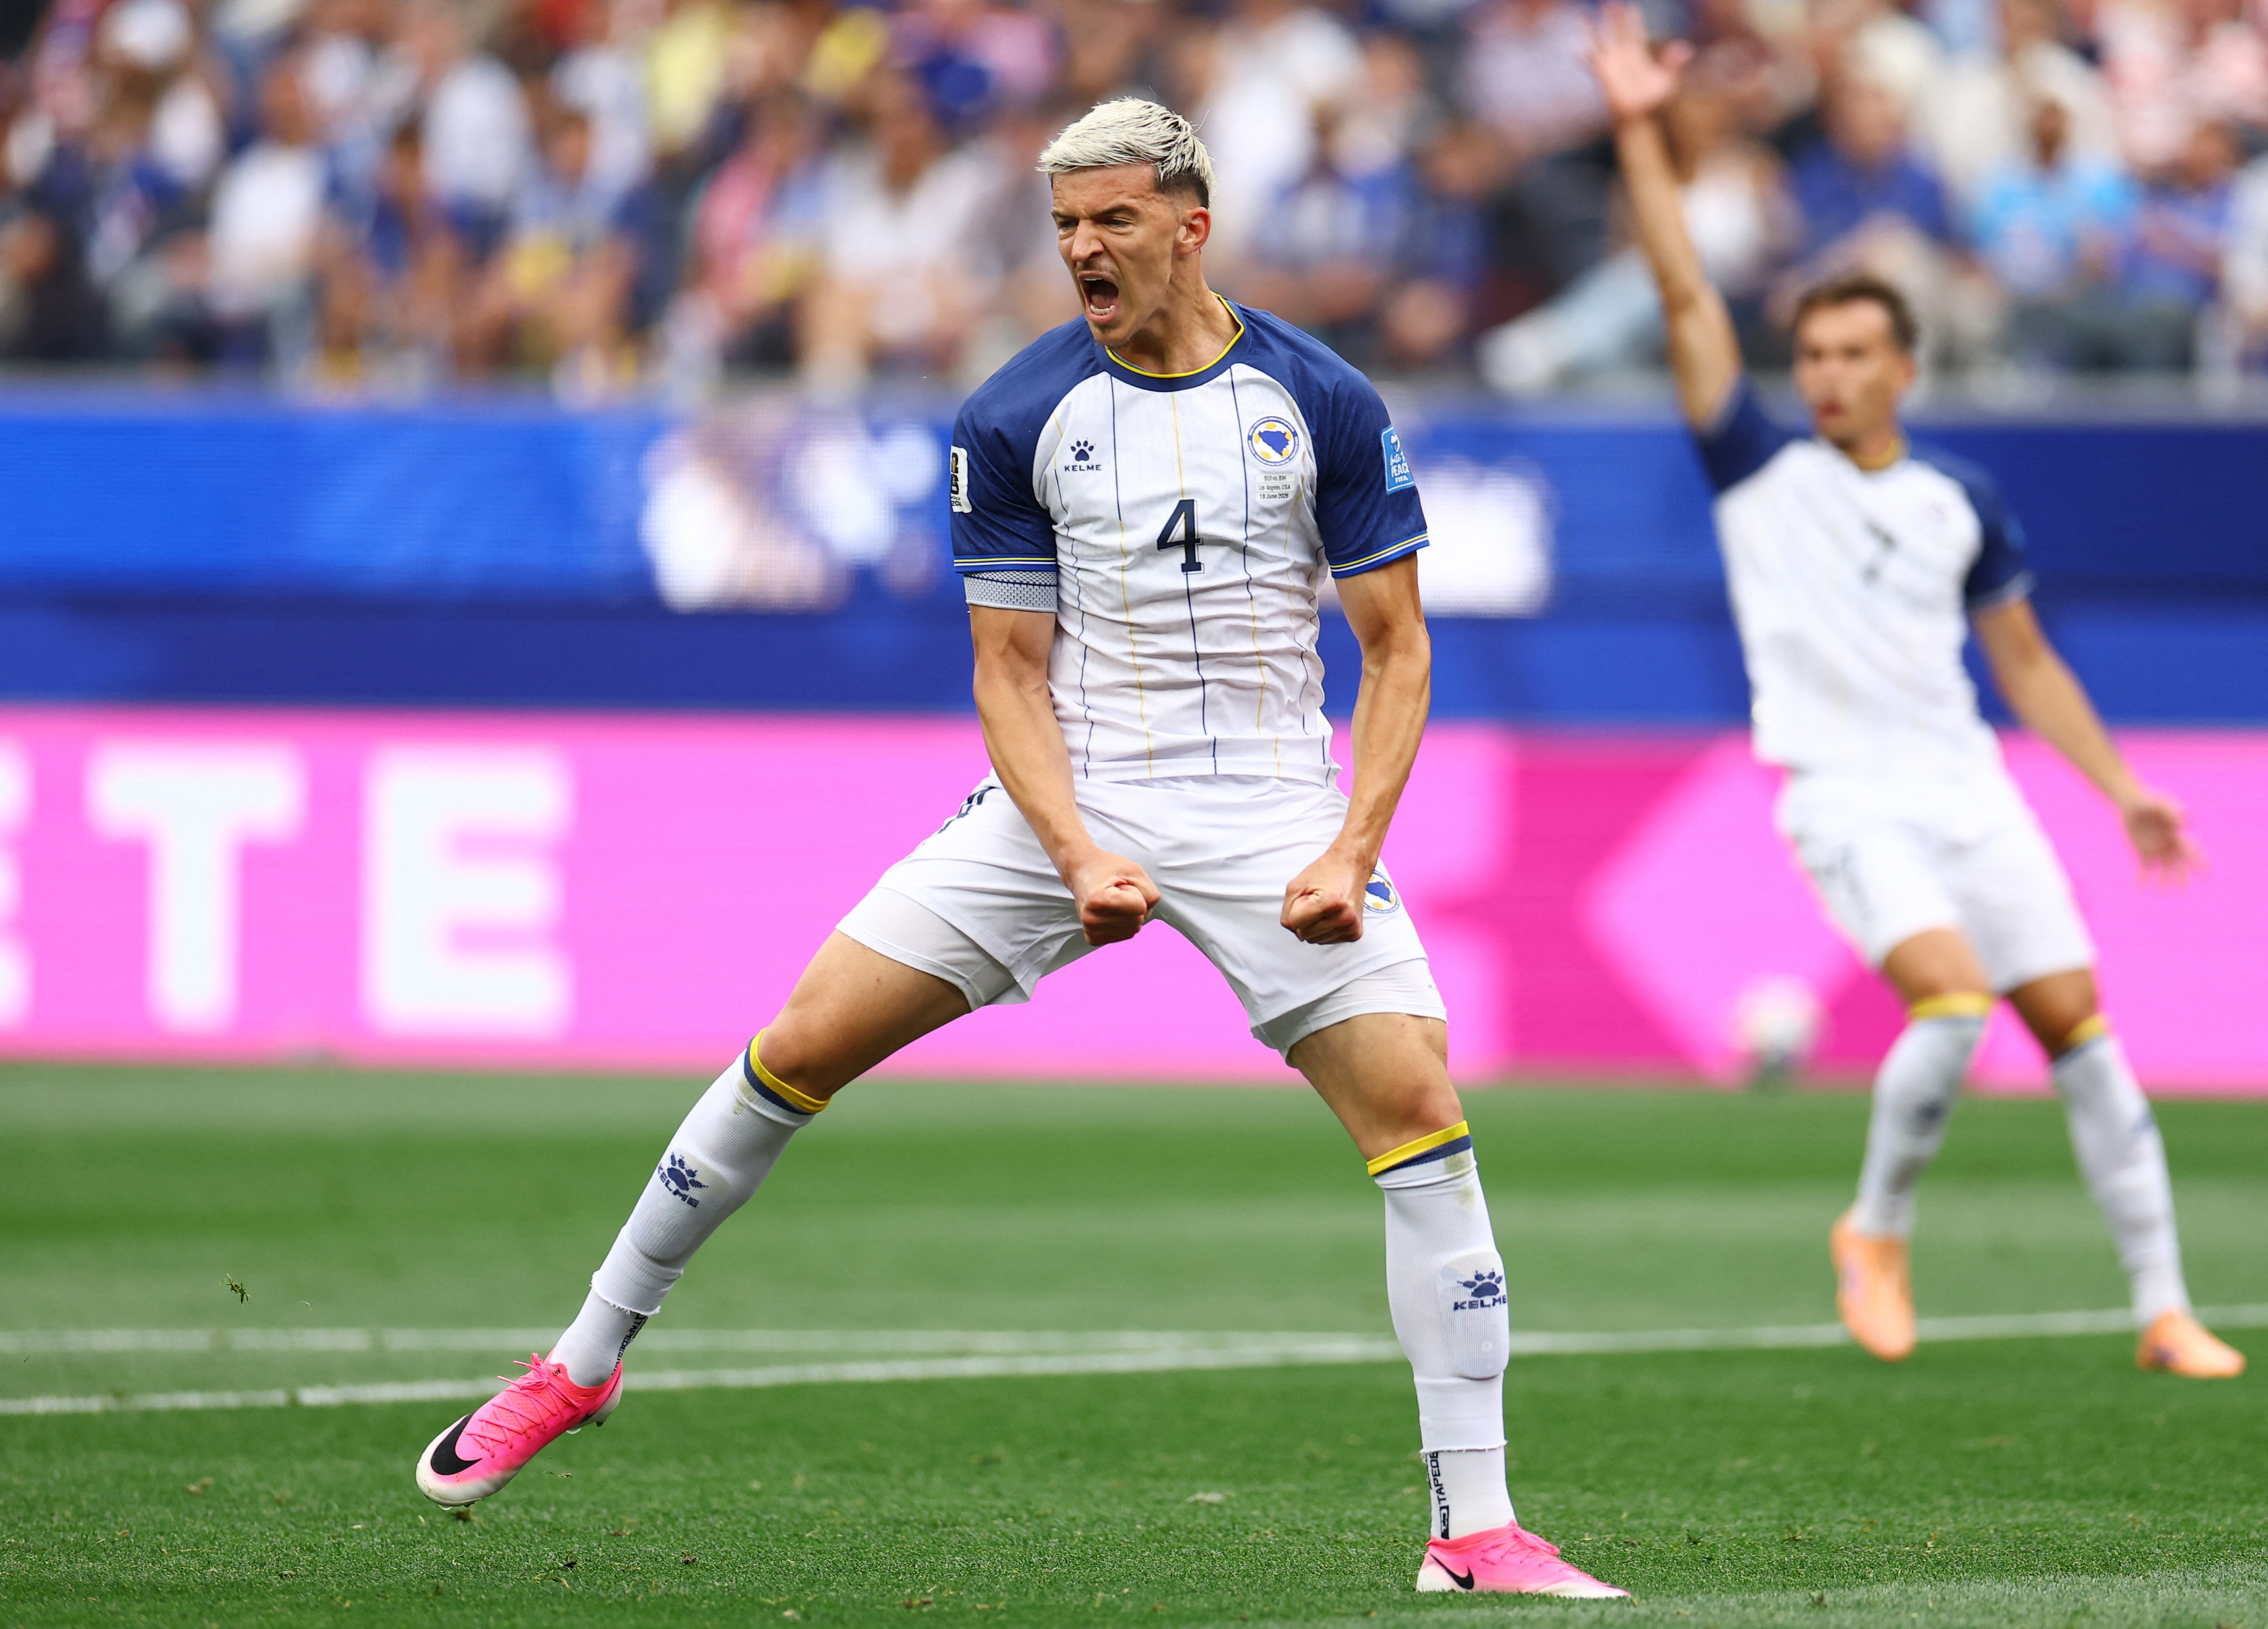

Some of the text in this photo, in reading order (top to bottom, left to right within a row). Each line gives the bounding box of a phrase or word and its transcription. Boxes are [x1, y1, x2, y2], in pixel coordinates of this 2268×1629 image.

[1157, 499, 1204, 575] 4
[0, 742, 575, 1037] TE
[658, 1162, 699, 1208] KELME
[1453, 1295, 1507, 1311] KELME
[612, 1320, 643, 1374] TAPEDESI
